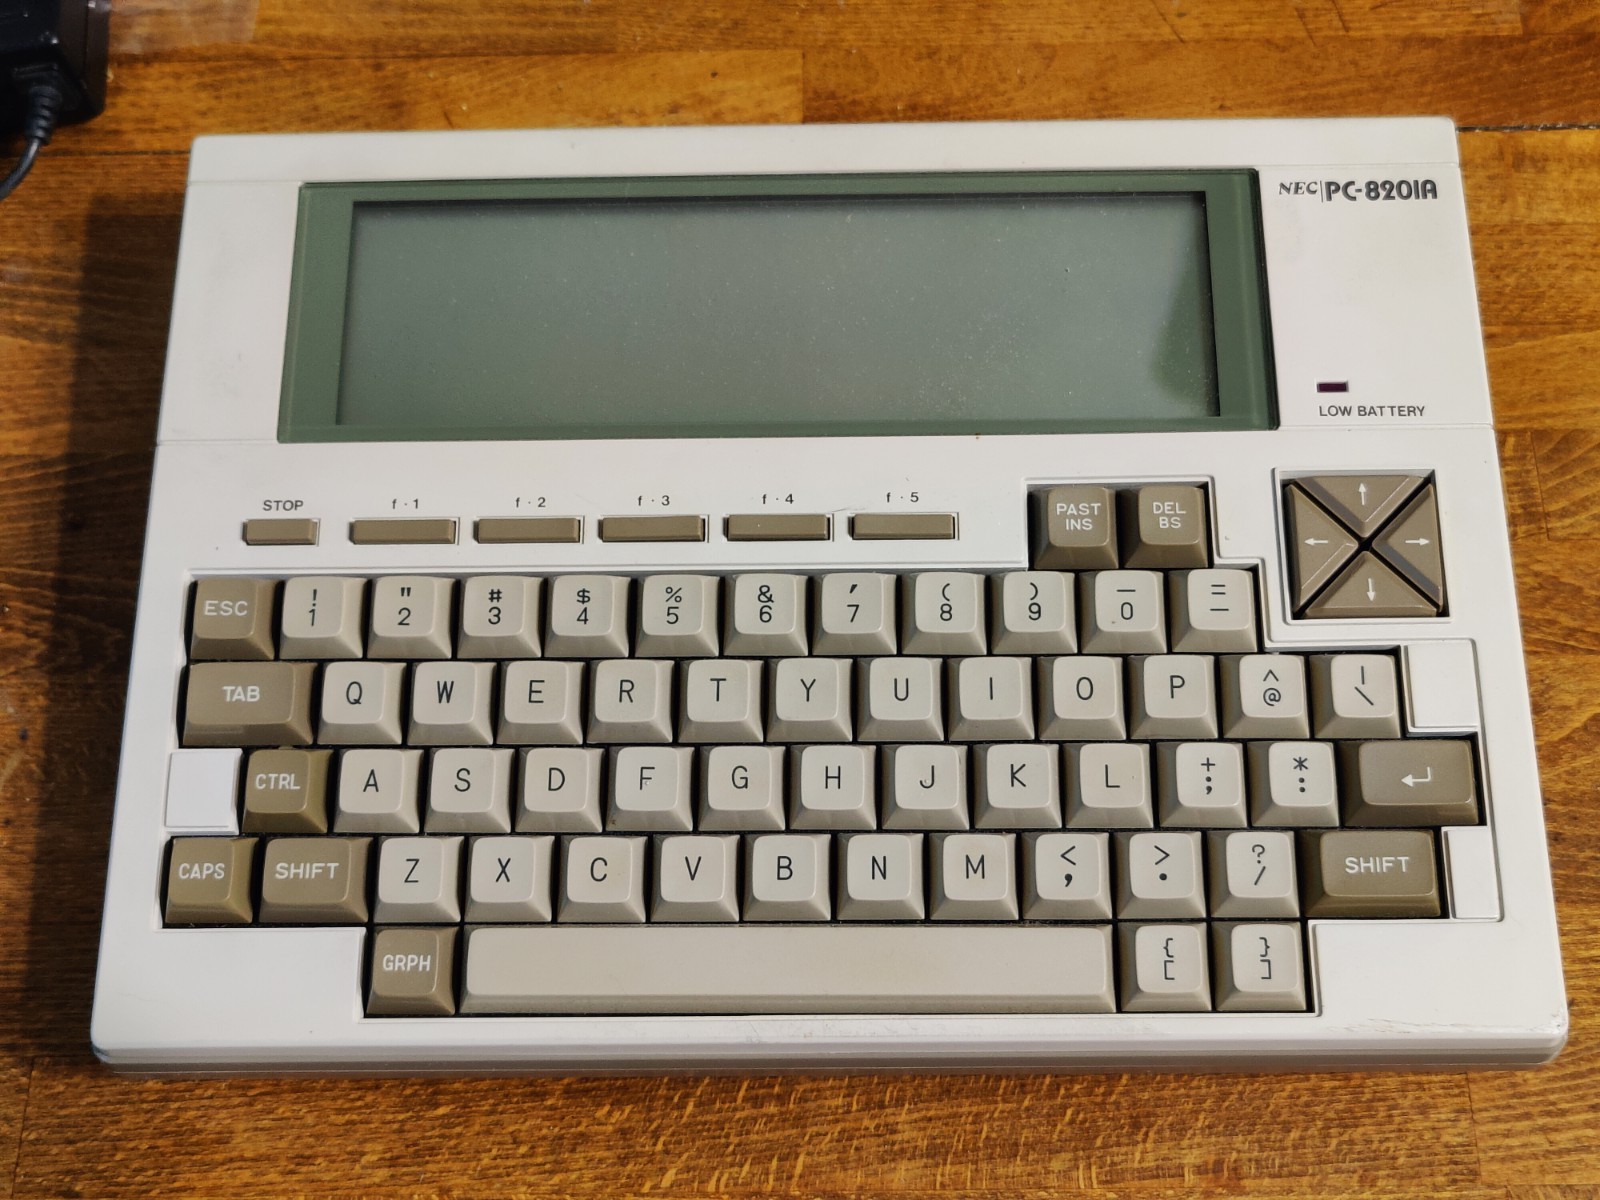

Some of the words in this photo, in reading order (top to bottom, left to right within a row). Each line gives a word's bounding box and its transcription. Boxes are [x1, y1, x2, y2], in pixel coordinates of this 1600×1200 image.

[1278, 181, 1318, 195] NEC
[1324, 179, 1438, 202] PC-8201A
[1318, 404, 1353, 417] LOW
[1357, 405, 1425, 417] BATTERY
[262, 499, 304, 512] STOP
[1056, 502, 1102, 516] PAST
[1152, 501, 1187, 515] DEL
[1065, 517, 1093, 531] INS
[1158, 516, 1182, 529] BS
[488, 588, 503, 603] #
[576, 588, 591, 605] $
[665, 586, 683, 603] %
[757, 584, 775, 604] &
[941, 582, 951, 602] (
[1029, 582, 1039, 601] )
[203, 599, 248, 617] ESC
[308, 608, 316, 627] 1
[397, 607, 412, 626] 2
[487, 606, 502, 625] 3
[576, 606, 589, 625] 4
[666, 606, 680, 625] 5
[759, 605, 773, 624] 6
[846, 603, 860, 623] 7
[939, 603, 953, 622] 8
[1028, 602, 1042, 621] 9
[1120, 601, 1134, 621] 0
[222, 685, 261, 702] TAB
[345, 680, 363, 706] Q
[436, 680, 455, 704] W
[528, 679, 545, 704] E
[618, 679, 635, 704] R
[709, 677, 727, 702] T
[800, 678, 817, 703] Y
[893, 677, 909, 702] U
[1075, 676, 1094, 701] O
[1169, 674, 1186, 699] P
[1262, 687, 1282, 707] @
[1010, 763, 1027, 788] K
[1200, 757, 1216, 773] +
[255, 773, 301, 790] CTRL
[362, 768, 380, 793] A
[454, 767, 471, 793] S
[547, 767, 566, 792] D
[639, 766, 656, 791] F
[731, 765, 749, 790] G
[824, 765, 841, 790] H
[919, 764, 935, 790] J
[1104, 764, 1121, 789] L
[1060, 845, 1077, 866] <
[1153, 845, 1170, 866] >
[1251, 843, 1266, 865] ?
[178, 862, 225, 880] CAPS
[274, 862, 340, 880] SHIFT
[403, 858, 420, 884] Z
[495, 857, 512, 883] X
[590, 856, 608, 883] C
[684, 855, 702, 881] V
[776, 855, 794, 881] B
[871, 855, 887, 881] N
[965, 854, 986, 880] M
[1345, 856, 1410, 874] SHIFT
[1163, 937, 1175, 959] {
[1259, 936, 1271, 958] }
[382, 954, 431, 972] GRPH
[1163, 959, 1175, 981] [
[1259, 958, 1272, 980] ]
